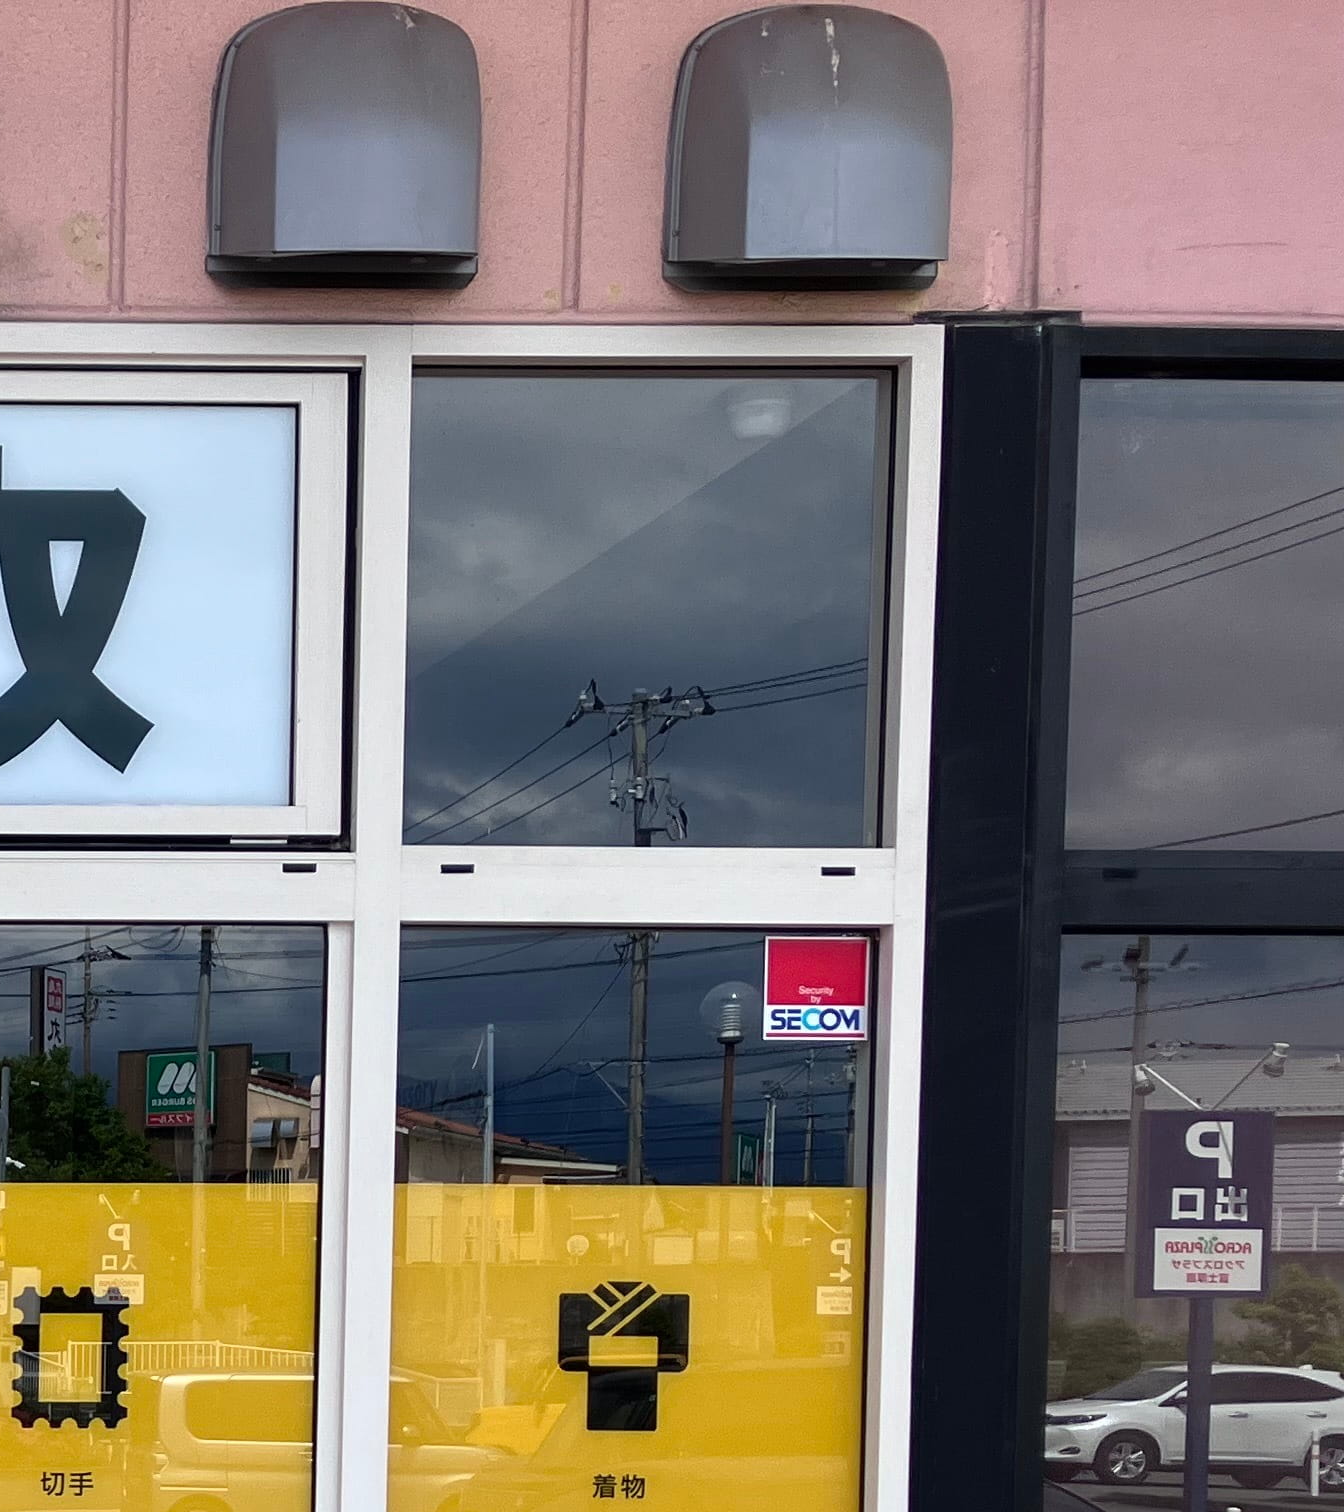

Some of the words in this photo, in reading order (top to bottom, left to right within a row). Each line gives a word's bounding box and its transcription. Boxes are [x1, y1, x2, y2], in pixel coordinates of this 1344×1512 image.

[798, 985, 834, 997] Security
[810, 996, 821, 1005] by
[771, 1007, 860, 1031] SECOM
[40, 1472, 95, 1497] 切手
[592, 1474, 647, 1500] 着物
